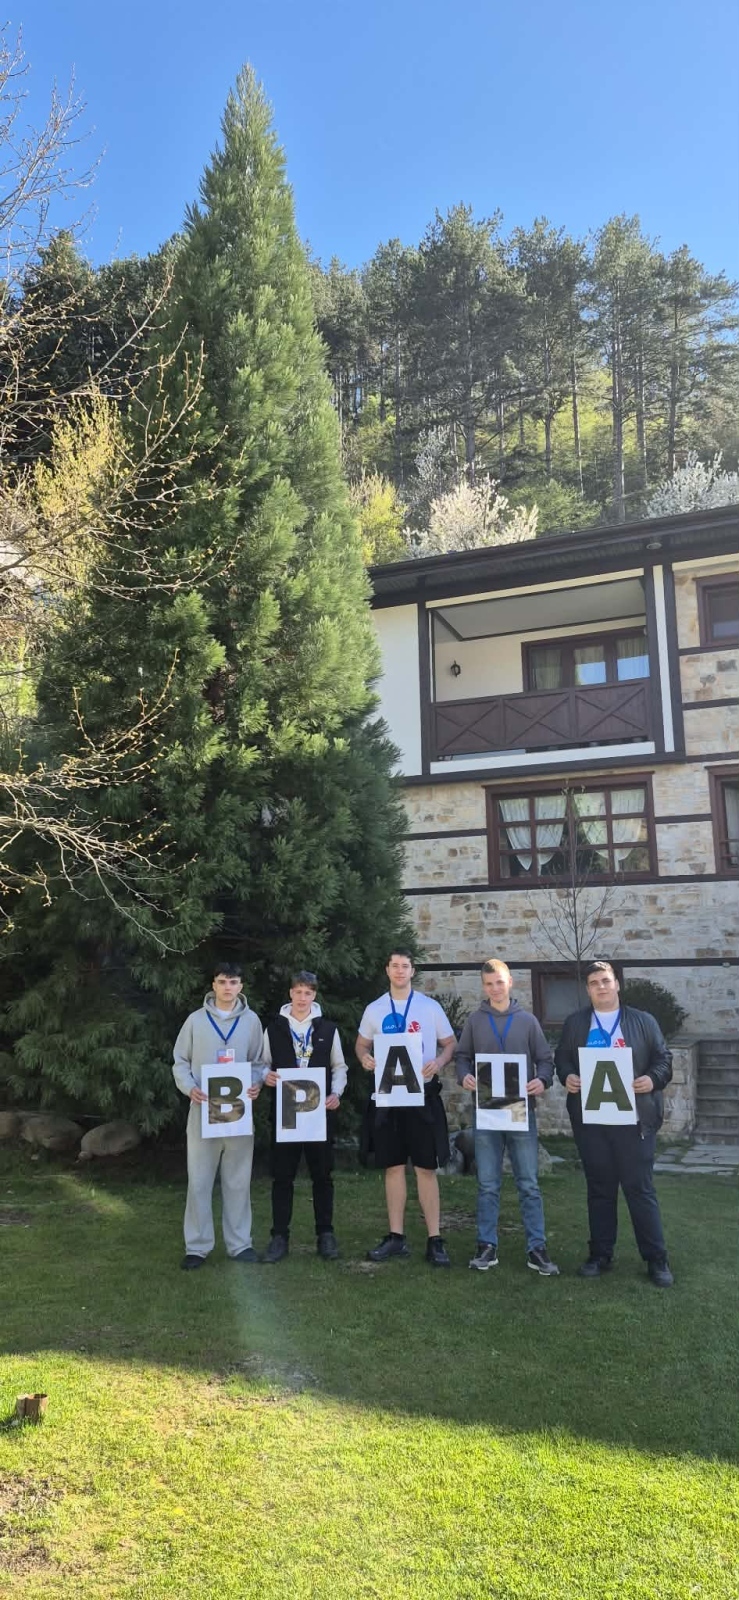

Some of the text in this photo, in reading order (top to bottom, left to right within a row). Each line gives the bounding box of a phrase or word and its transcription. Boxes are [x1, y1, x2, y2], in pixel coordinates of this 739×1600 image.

[207, 1045, 634, 1129] В Р А Ц А
